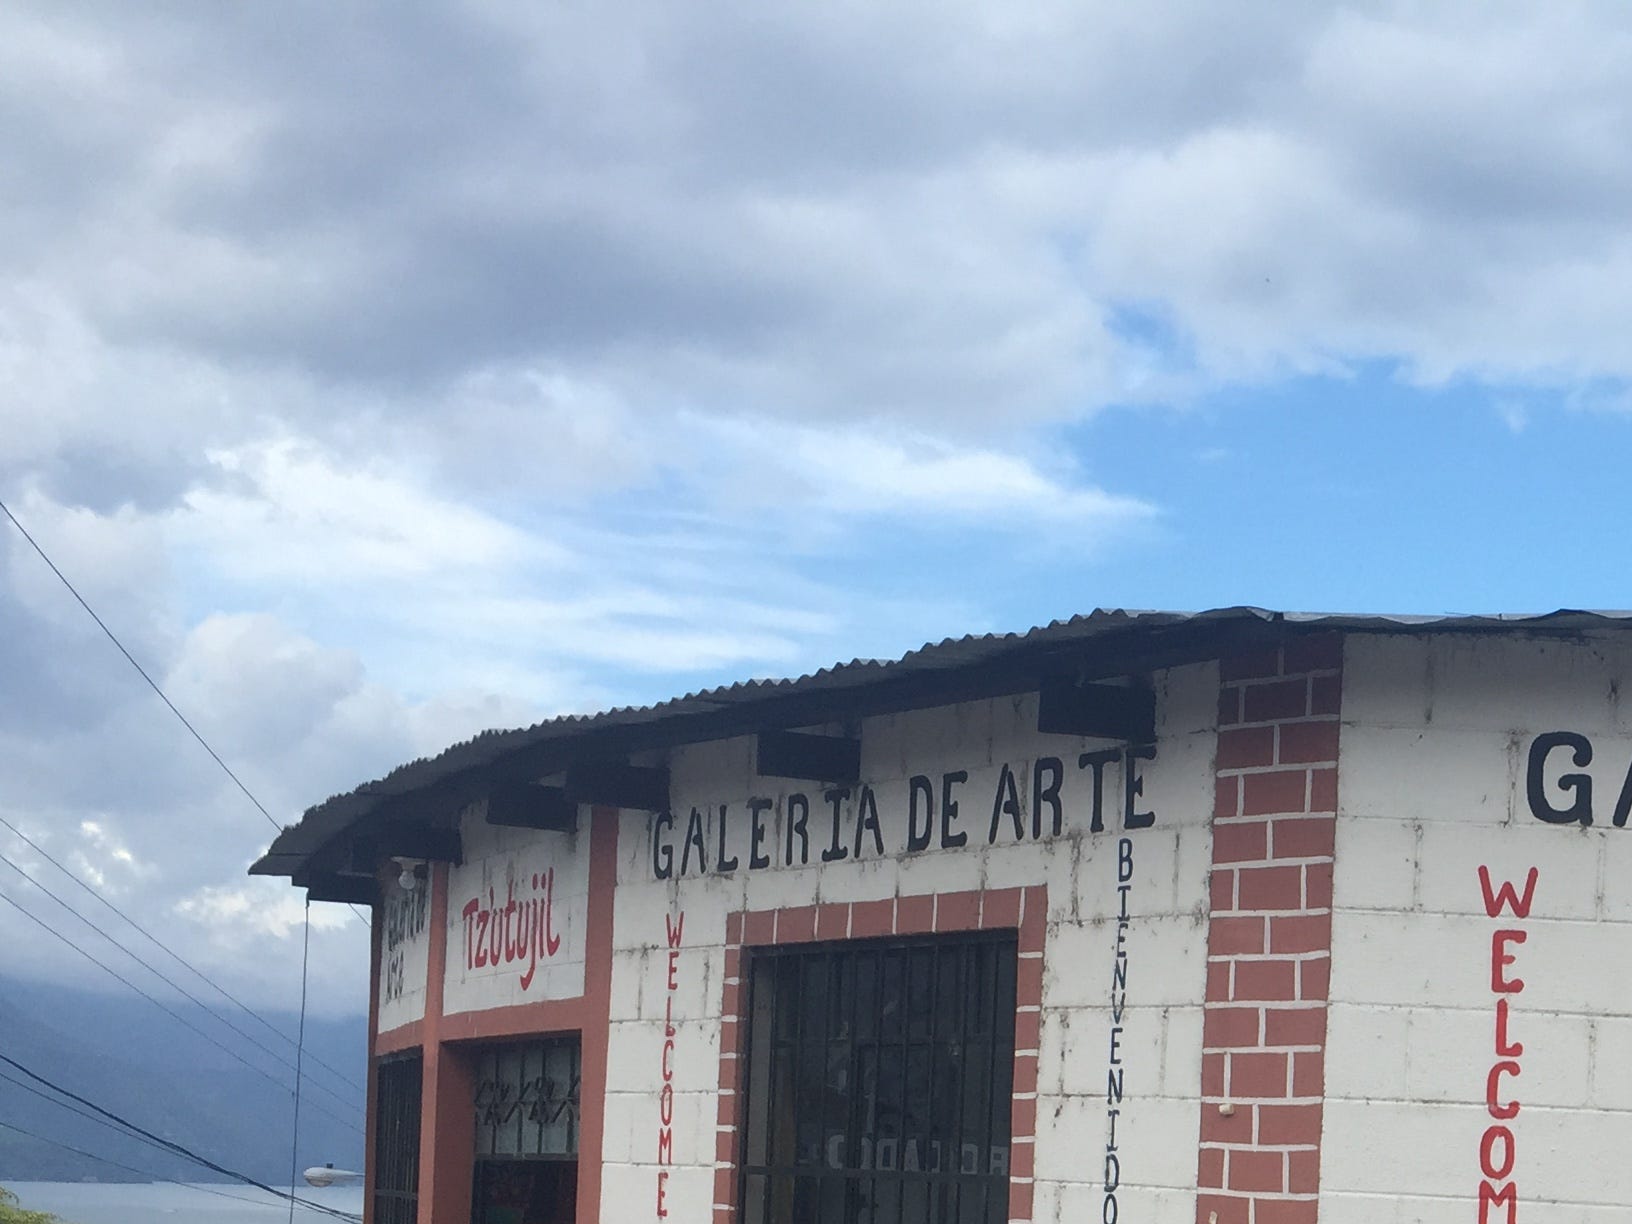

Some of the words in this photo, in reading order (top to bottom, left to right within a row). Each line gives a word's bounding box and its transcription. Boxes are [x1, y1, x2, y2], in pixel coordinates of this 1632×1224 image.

[653, 784, 884, 880] GALERIA
[906, 769, 970, 854] DE
[988, 748, 1156, 844] ARTE
[656, 911, 685, 1218] WELCOME
